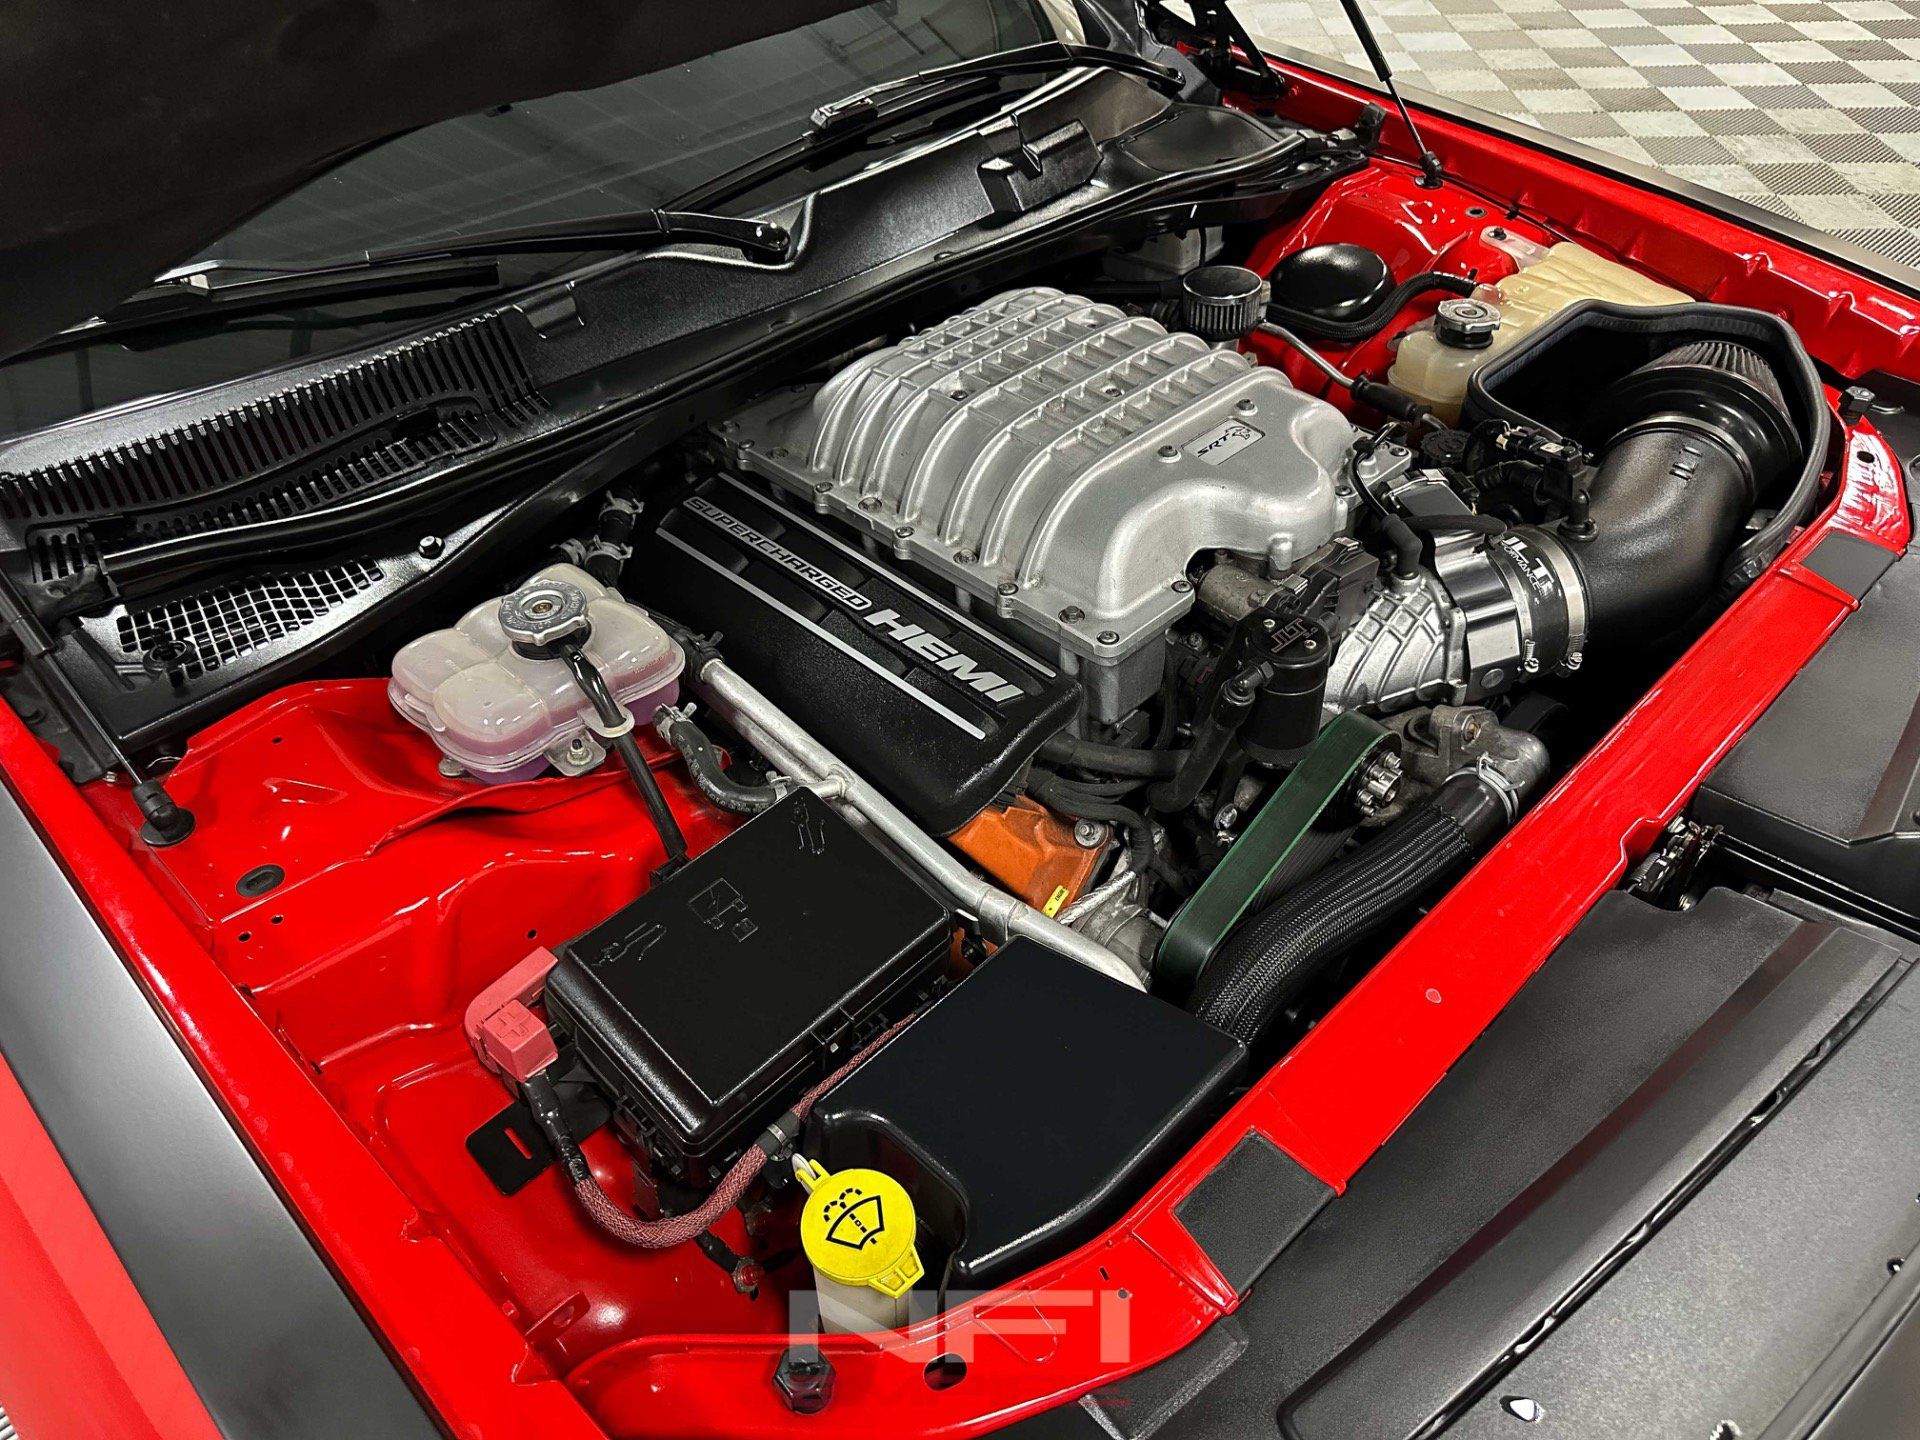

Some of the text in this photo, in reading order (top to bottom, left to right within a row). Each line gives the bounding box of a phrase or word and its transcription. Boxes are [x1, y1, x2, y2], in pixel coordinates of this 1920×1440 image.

[1197, 433, 1230, 457] SRT
[686, 497, 869, 609] SUPERCHARGED
[1502, 536, 1555, 583] JLT
[864, 609, 1025, 703] HEMI
